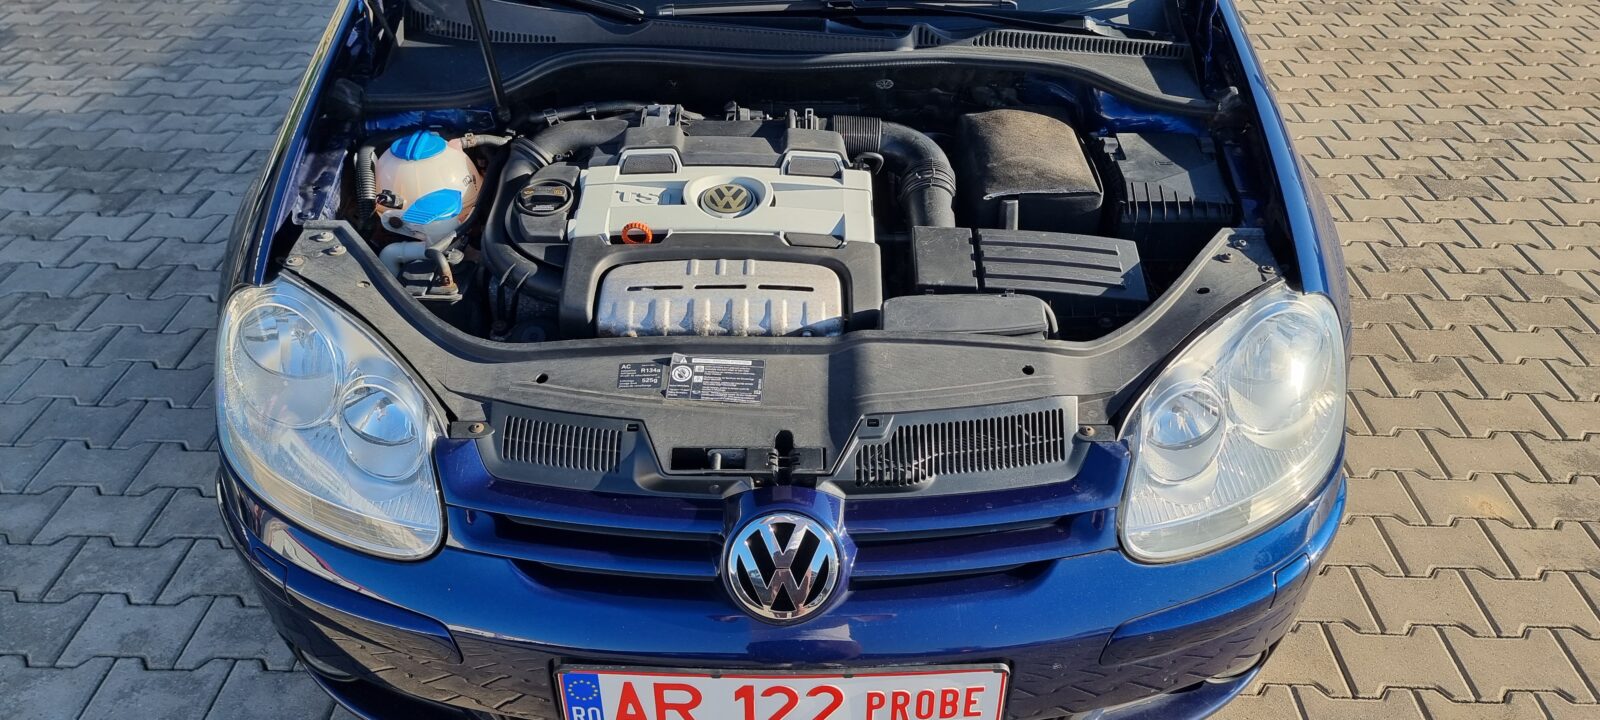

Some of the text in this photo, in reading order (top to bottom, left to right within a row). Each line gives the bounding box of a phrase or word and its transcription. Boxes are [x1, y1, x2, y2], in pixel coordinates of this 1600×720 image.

[728, 513, 840, 620] VW
[571, 706, 601, 720] RO
[615, 681, 986, 720] AR 122 PROBE
